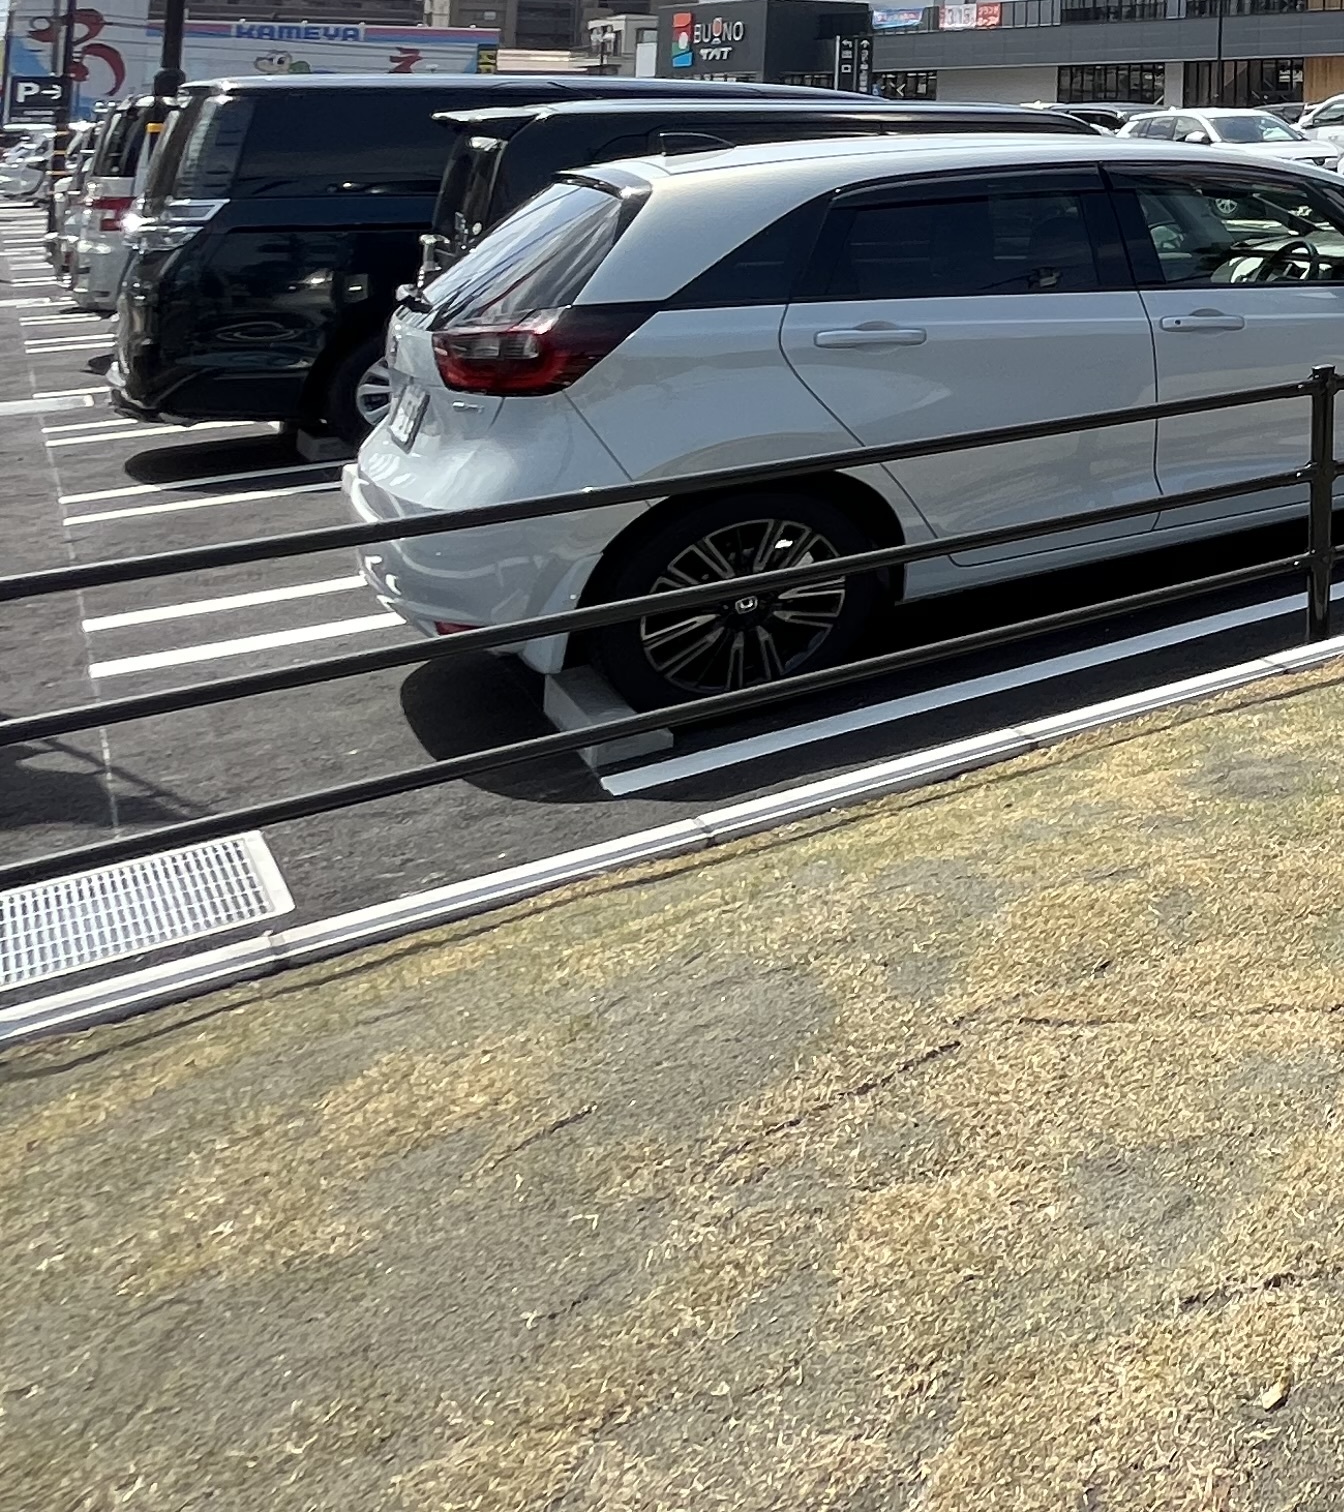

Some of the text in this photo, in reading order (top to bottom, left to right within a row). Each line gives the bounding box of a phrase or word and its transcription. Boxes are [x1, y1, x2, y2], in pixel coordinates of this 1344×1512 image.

[235, 24, 361, 41] KAMEYA
[694, 17, 743, 44] BUONO
[16, 82, 39, 103] P
